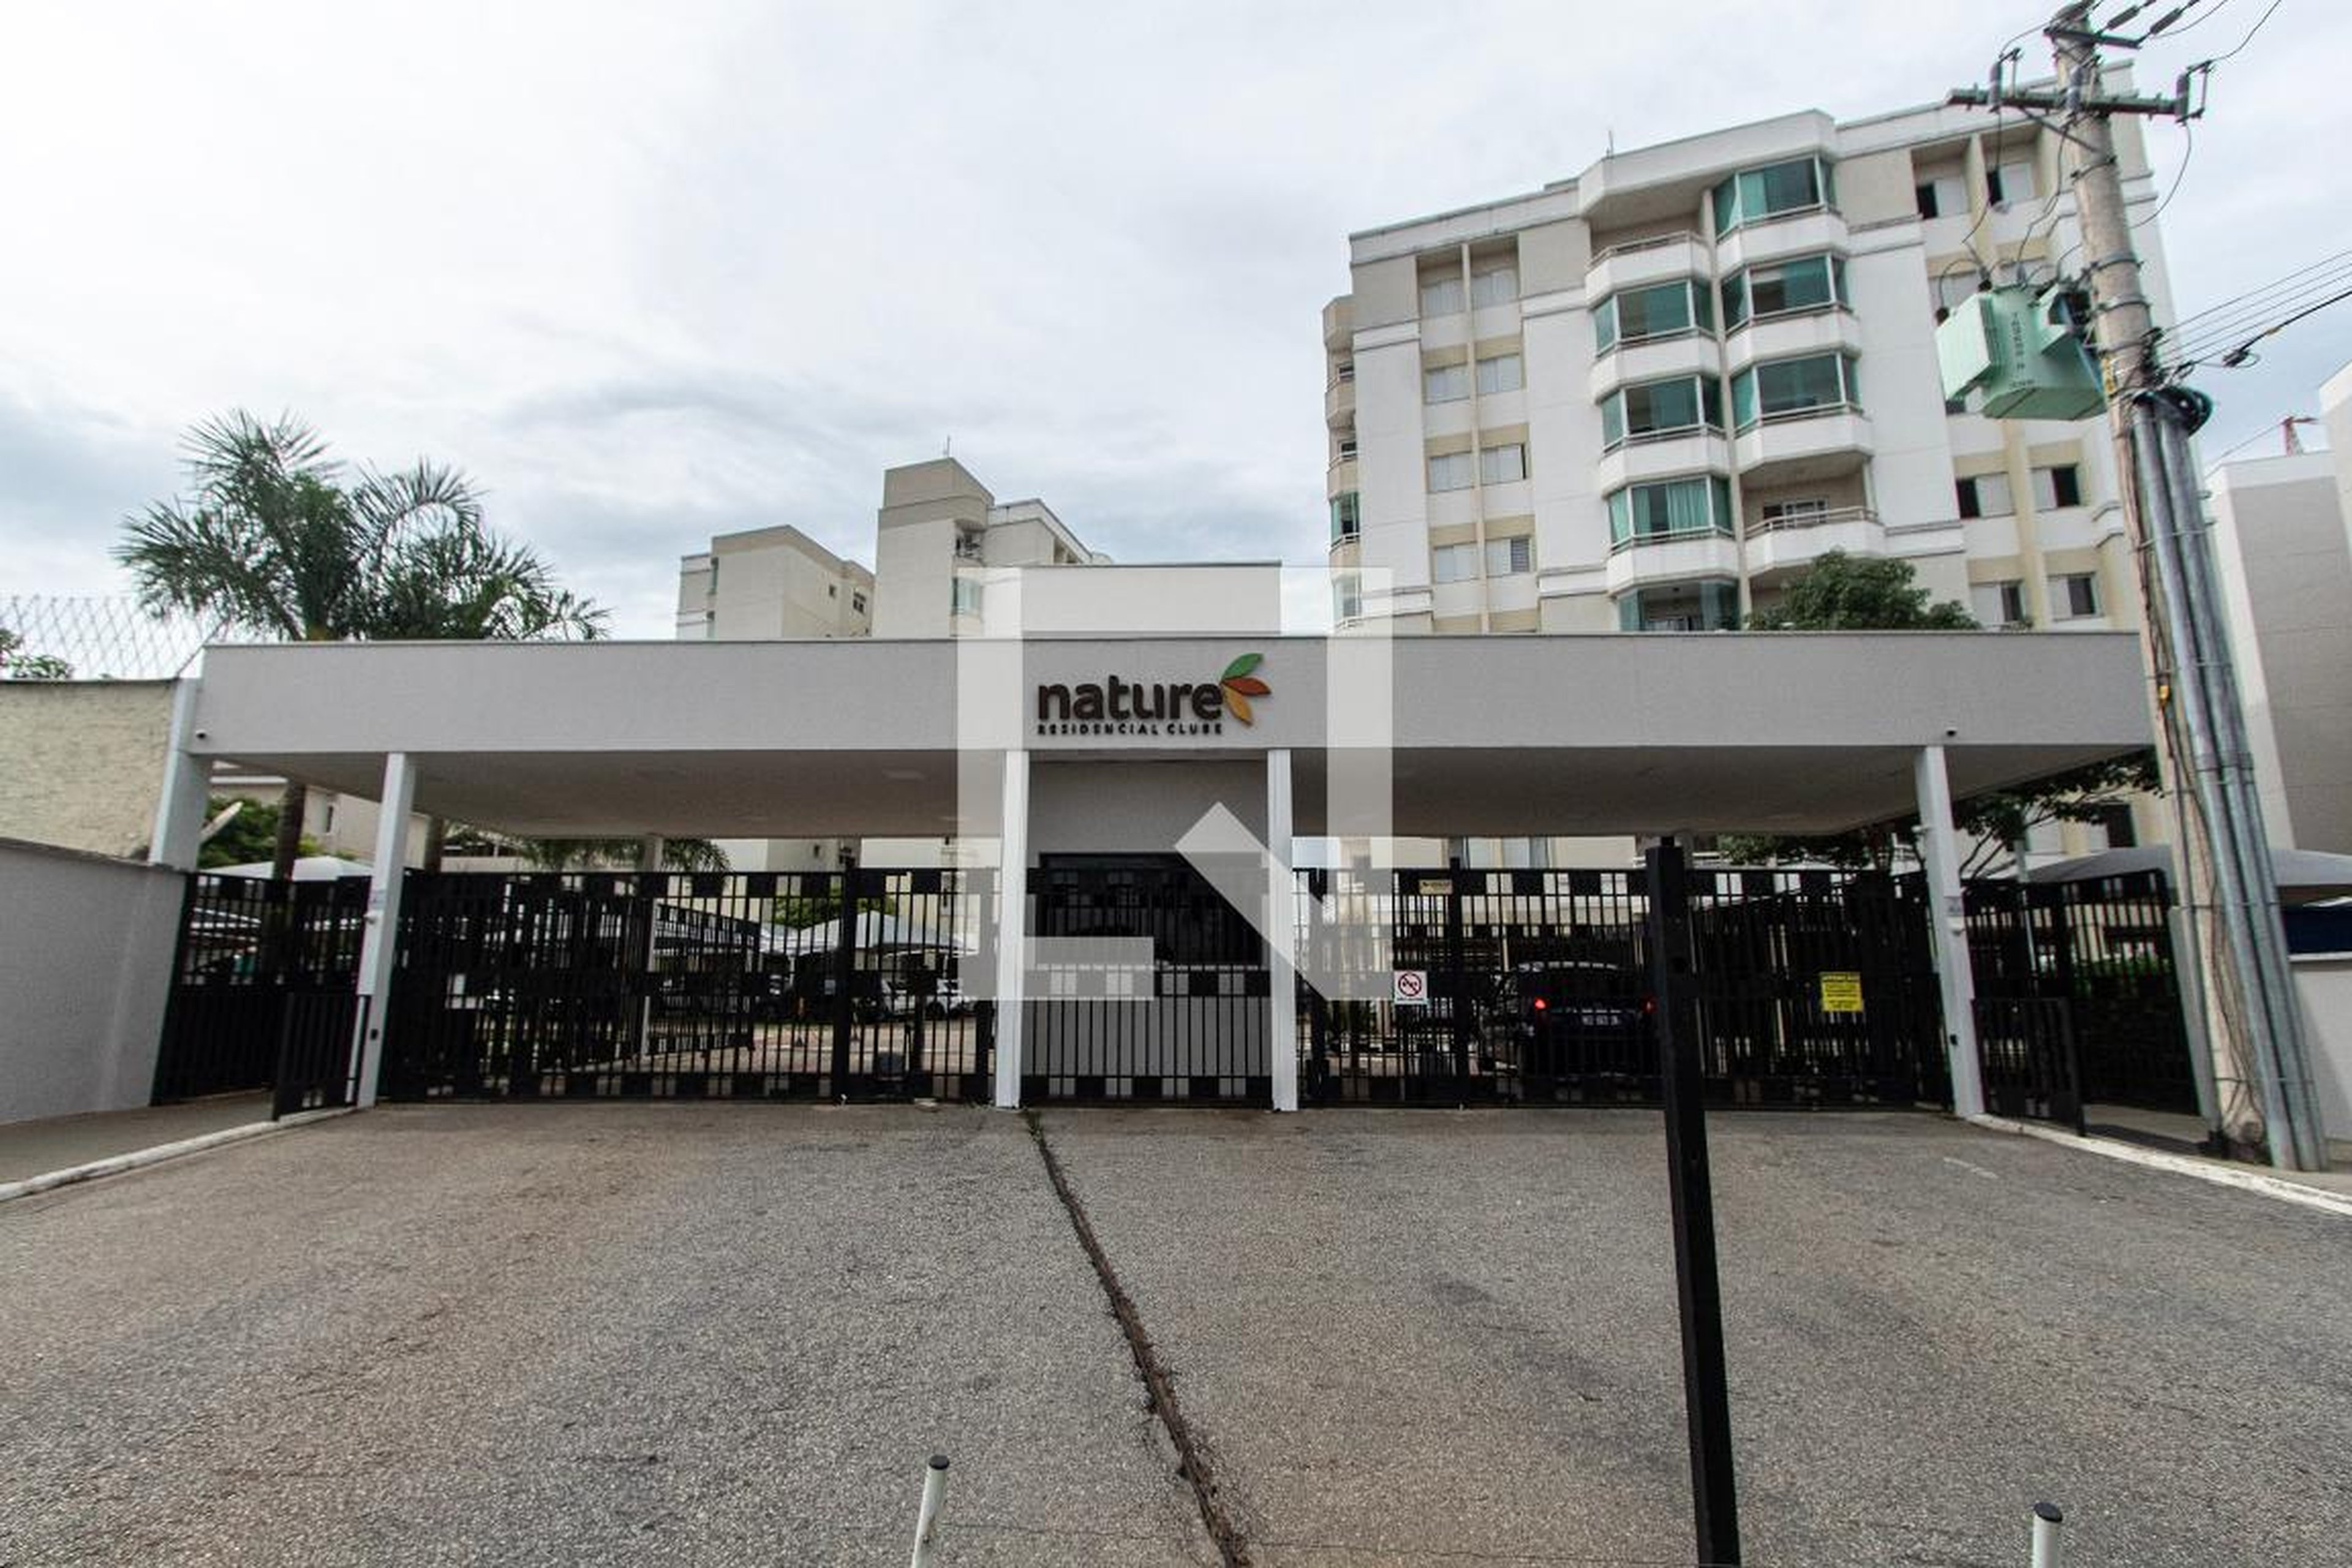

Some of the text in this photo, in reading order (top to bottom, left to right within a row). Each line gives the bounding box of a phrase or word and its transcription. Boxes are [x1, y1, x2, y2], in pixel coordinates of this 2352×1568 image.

[1038, 674, 1224, 720] nature
[1038, 723, 1223, 735] RESIDENCIAL CLUBE
